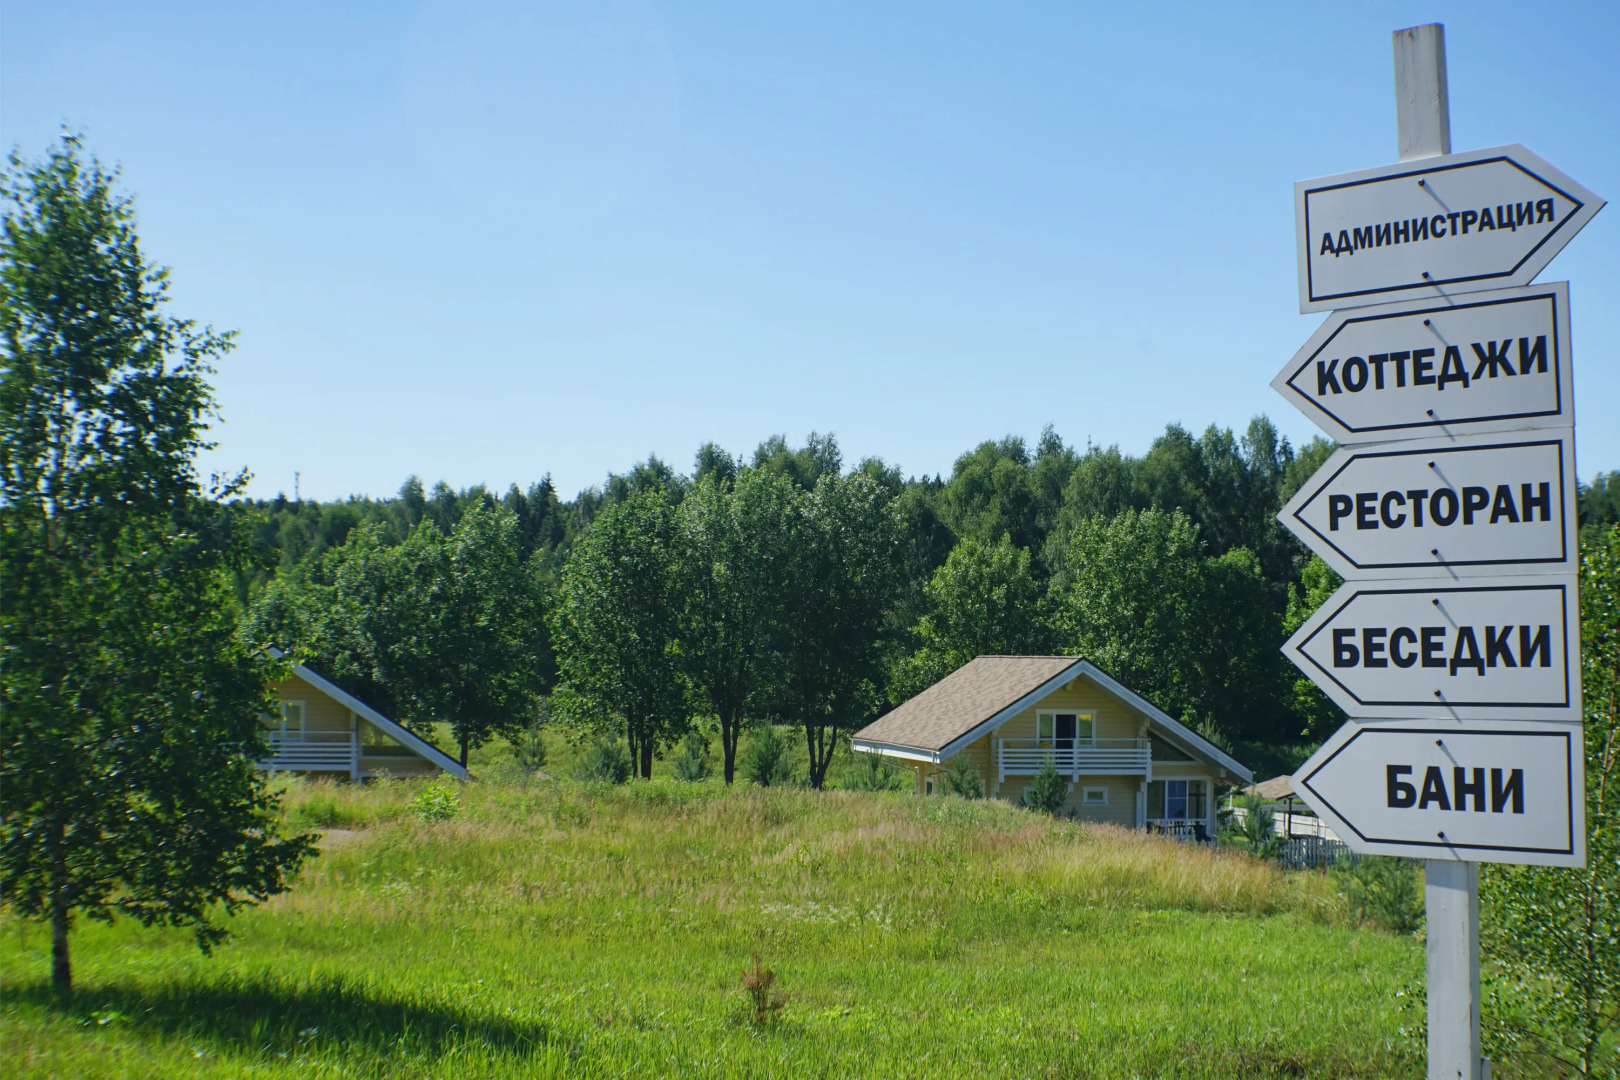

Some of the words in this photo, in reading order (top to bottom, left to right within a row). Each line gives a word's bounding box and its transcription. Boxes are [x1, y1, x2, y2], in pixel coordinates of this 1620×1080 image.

[1320, 198, 1555, 257] АДМИНИСТРАЦИЯ
[1316, 335, 1548, 396] КОТТЕДЖИ
[1328, 482, 1551, 531] РЕСТОРАН
[1332, 625, 1551, 676] БЕСЕДКИ
[1386, 764, 1524, 814] БАНИ
